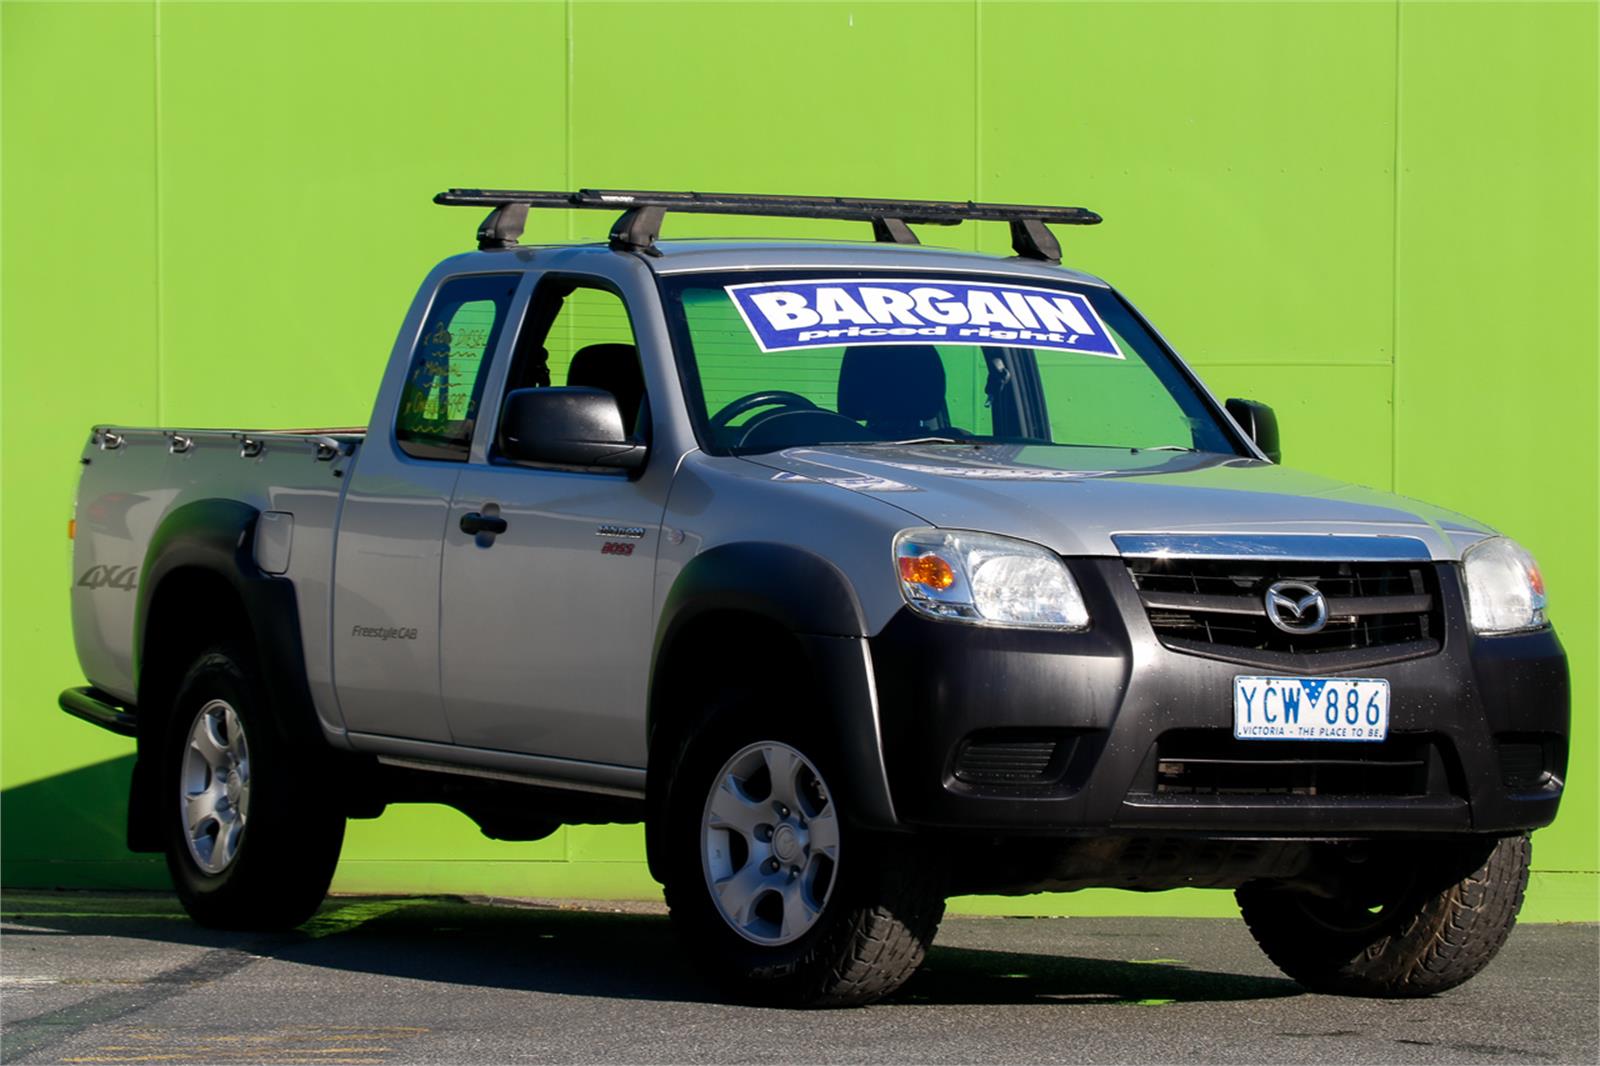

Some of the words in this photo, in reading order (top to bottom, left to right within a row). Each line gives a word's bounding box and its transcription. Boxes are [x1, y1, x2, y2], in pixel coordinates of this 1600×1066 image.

[749, 286, 1096, 336] BARGAIN
[797, 325, 948, 342] priced
[958, 326, 1080, 344] right!
[1240, 686, 1301, 724] YCW
[1325, 688, 1380, 726] 886
[1242, 725, 1285, 736] VICTORIA
[1298, 726, 1315, 737] THE
[1319, 727, 1347, 737] PLACE
[1351, 727, 1364, 738] TO
